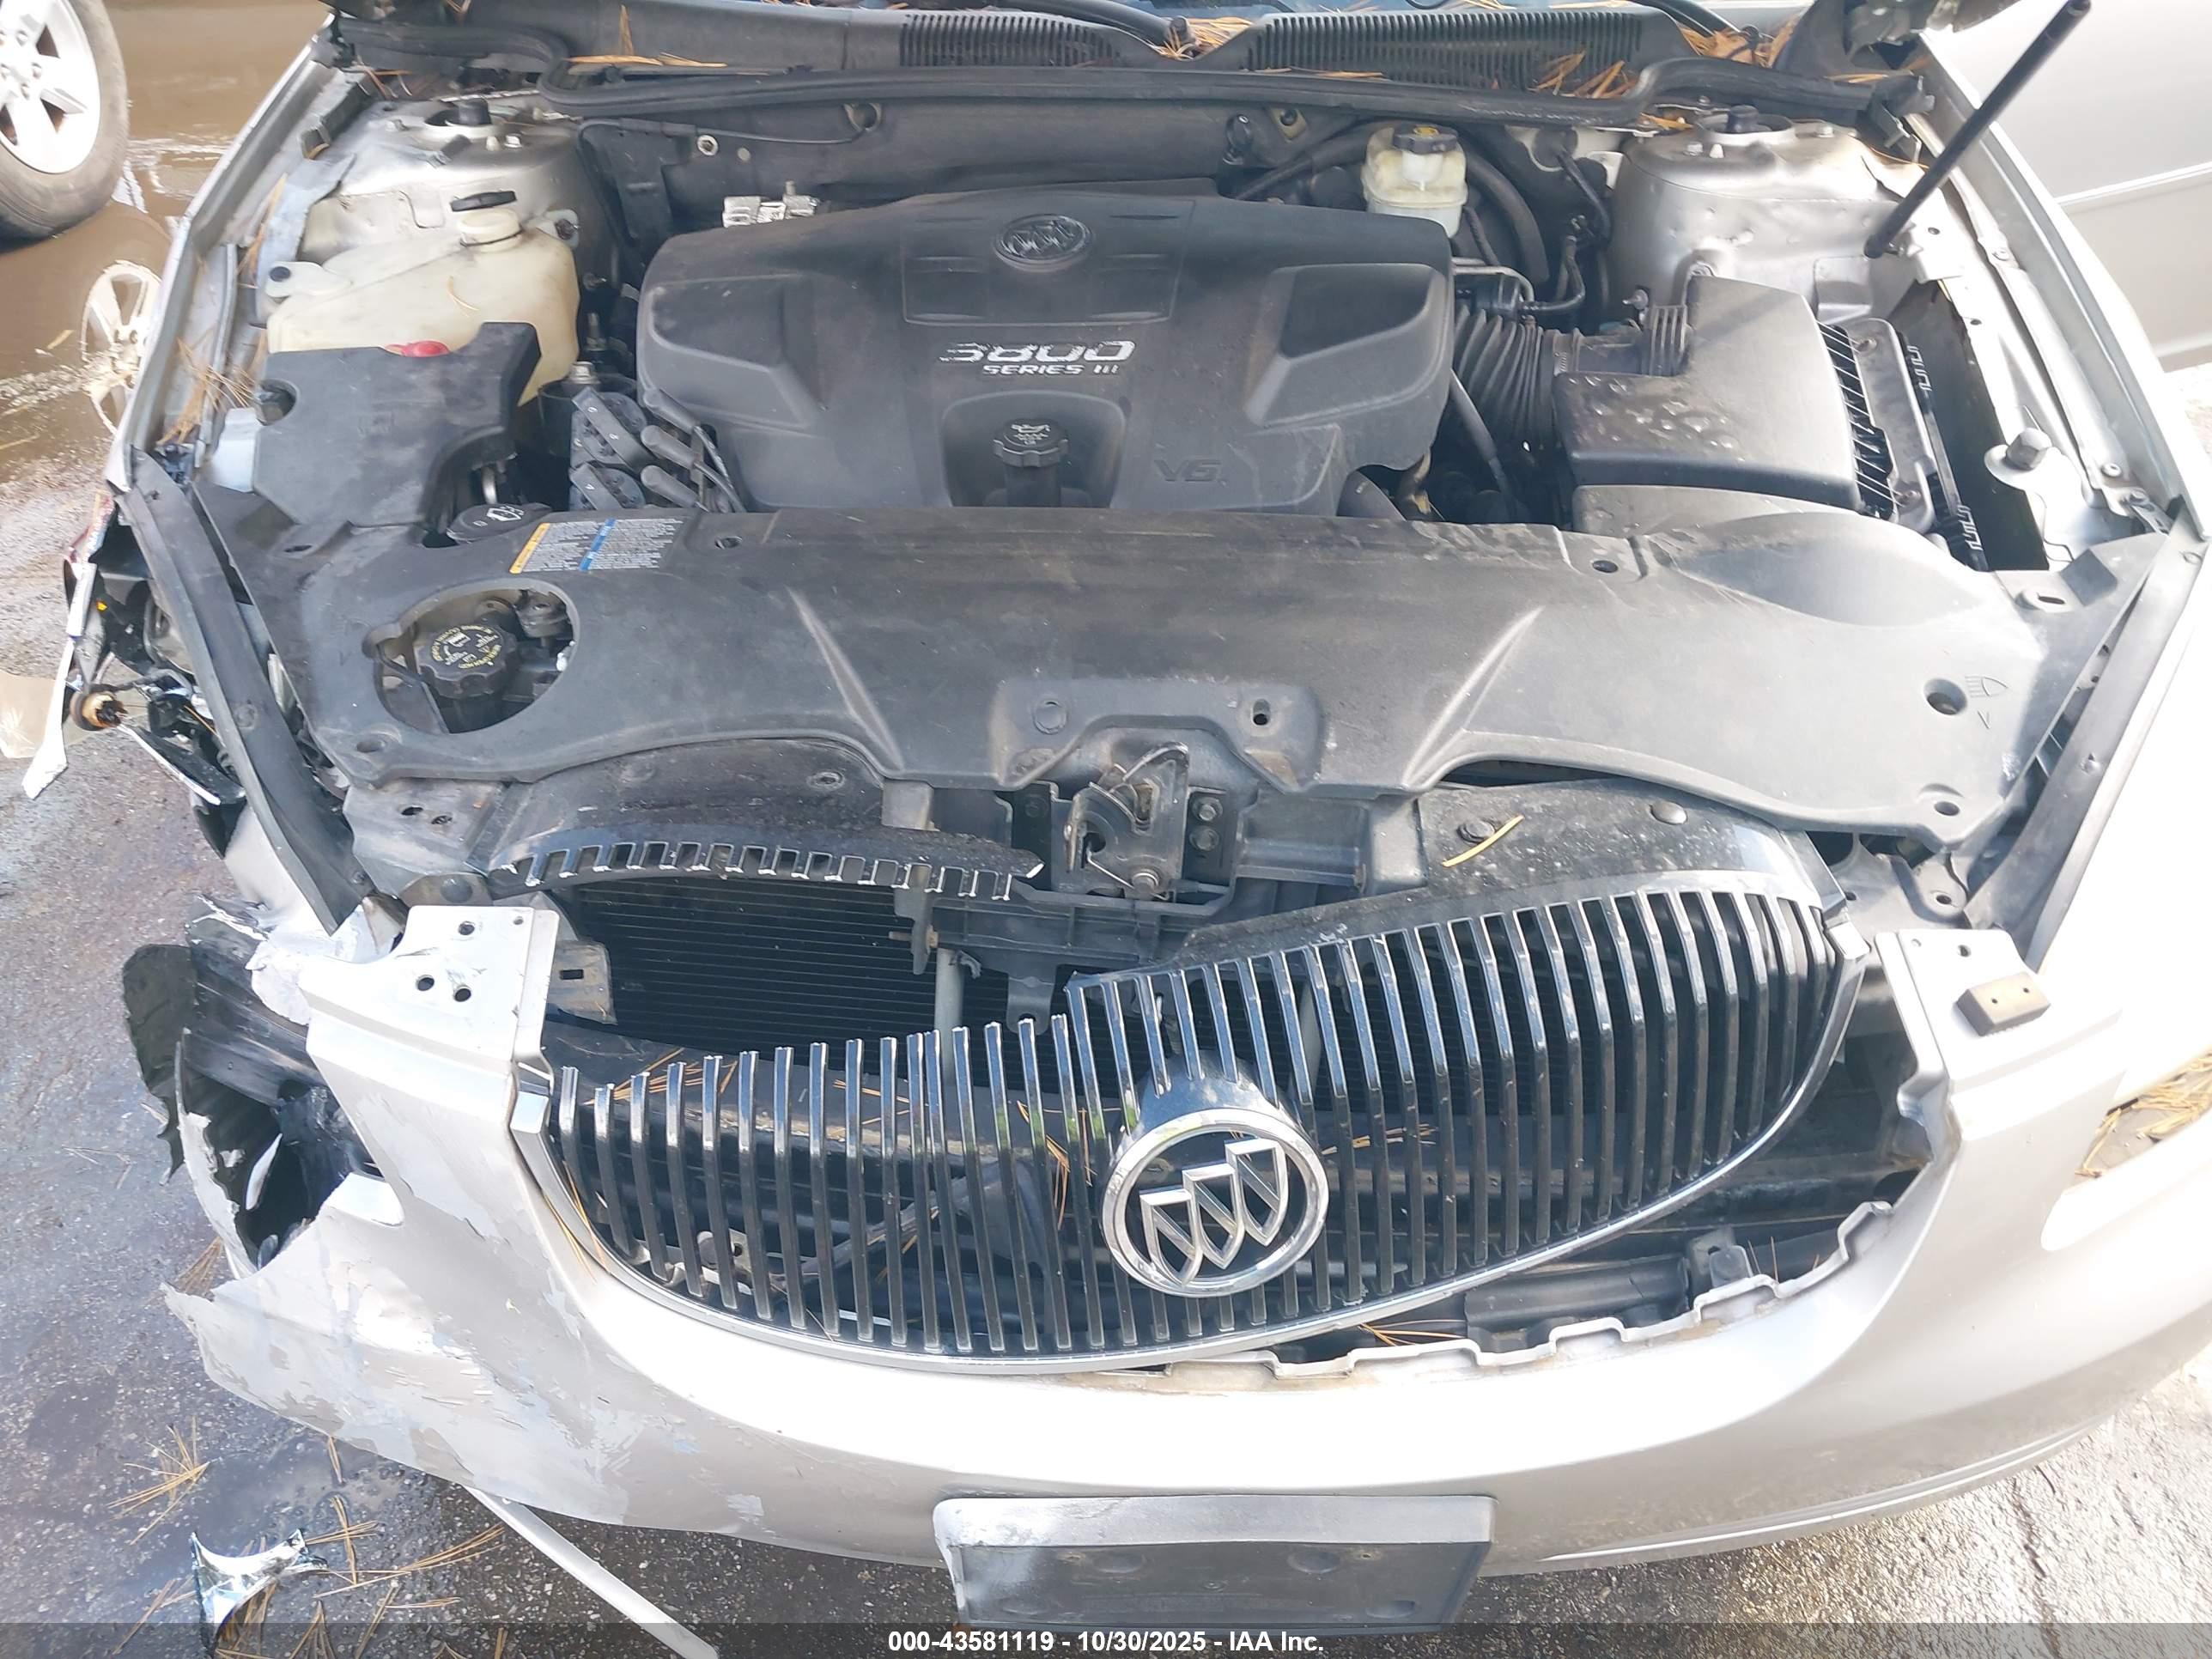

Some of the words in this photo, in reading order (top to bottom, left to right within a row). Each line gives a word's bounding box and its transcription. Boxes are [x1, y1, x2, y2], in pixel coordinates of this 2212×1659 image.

[939, 340, 1136, 363] 3800
[982, 364, 1085, 375] SERIES
[1092, 364, 1120, 374] III
[1153, 459, 1221, 483] V6
